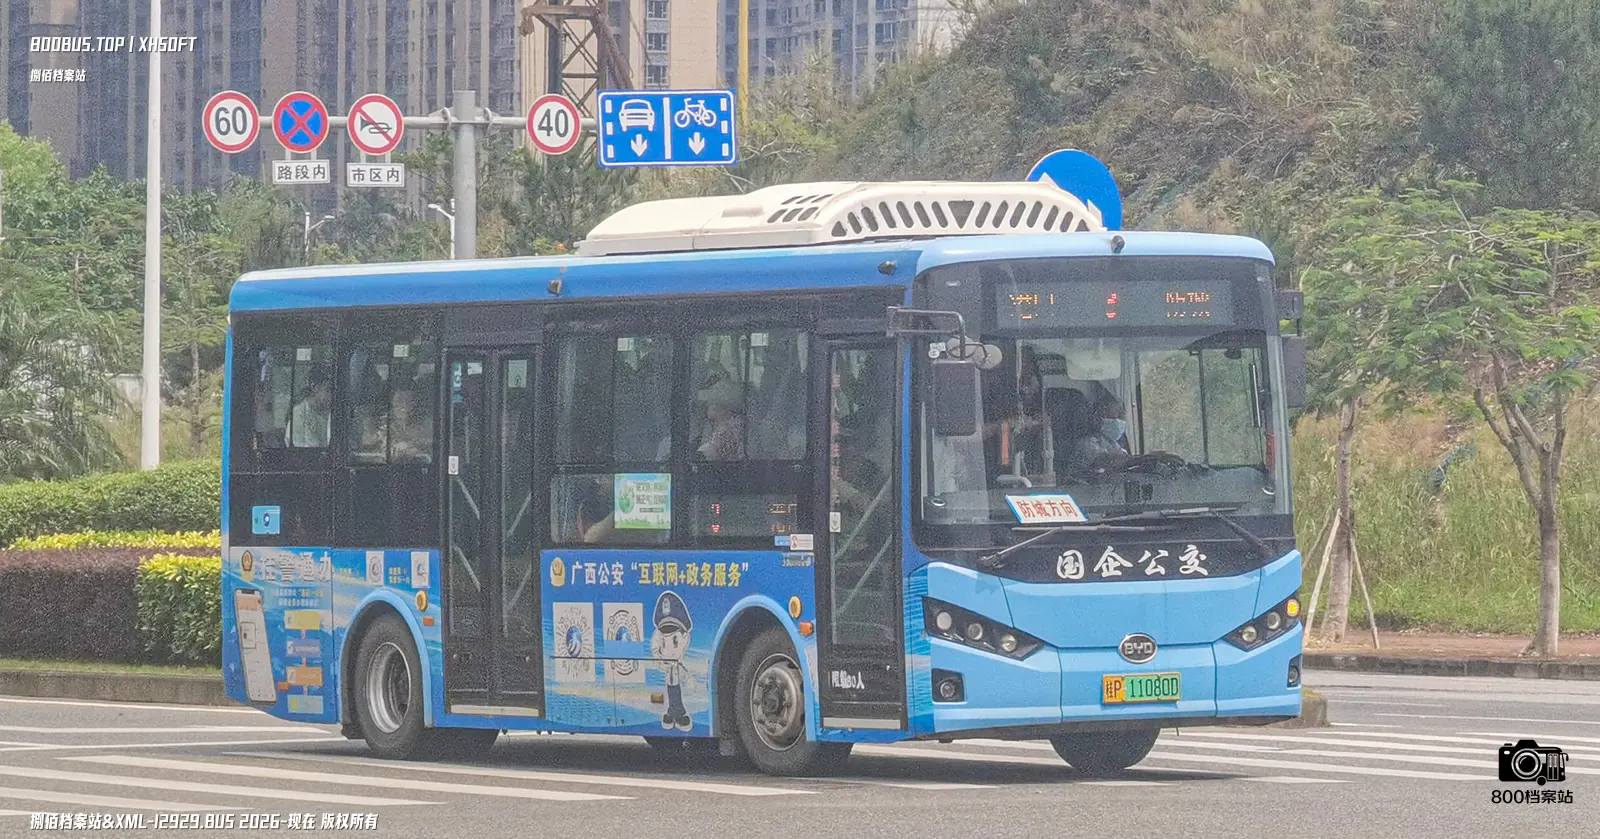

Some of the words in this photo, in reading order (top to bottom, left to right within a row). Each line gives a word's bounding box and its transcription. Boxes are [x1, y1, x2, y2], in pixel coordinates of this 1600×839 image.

[215, 106, 247, 136] 60
[538, 108, 569, 137] 40
[277, 164, 327, 181] 路段内
[352, 167, 400, 183] 市区内
[1016, 501, 1078, 518] 防城方向
[1057, 544, 1208, 580] 国企公交
[1124, 642, 1153, 655] BYD
